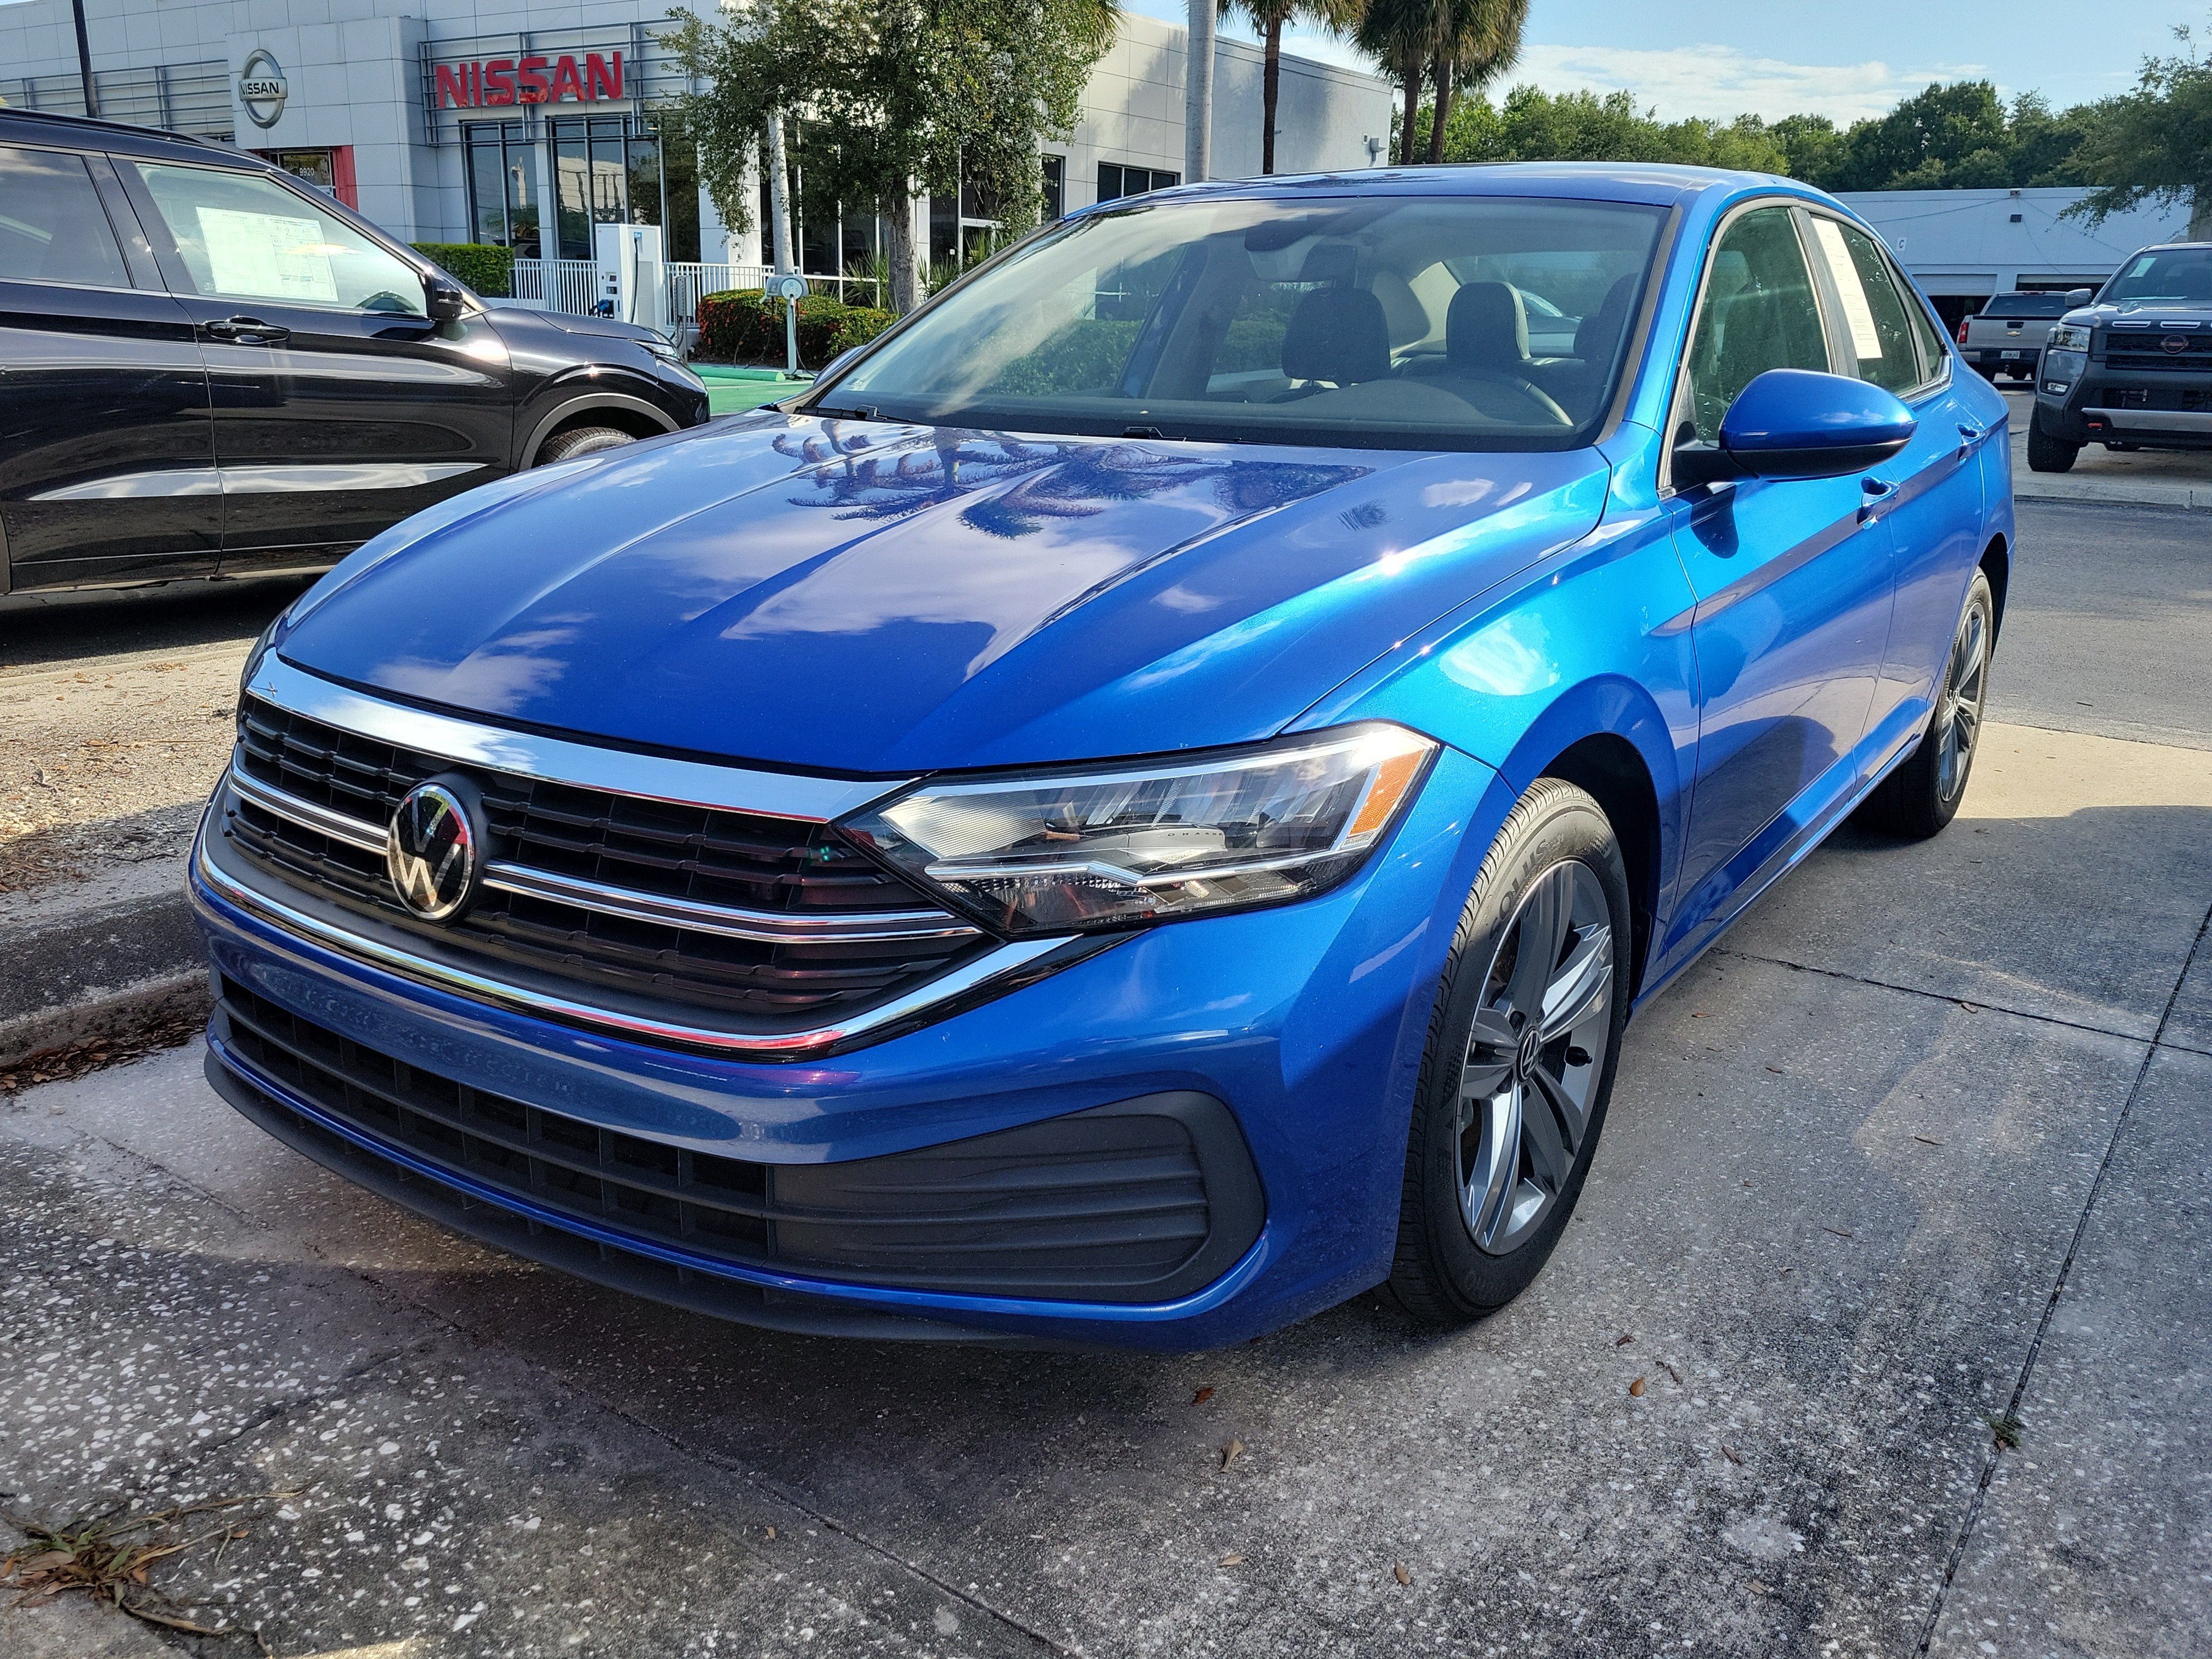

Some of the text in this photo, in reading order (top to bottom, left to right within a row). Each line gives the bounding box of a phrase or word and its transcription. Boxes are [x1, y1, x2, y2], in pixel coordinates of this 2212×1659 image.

[436, 51, 624, 109] NISSAN
[240, 82, 279, 95] NISSAN
[299, 167, 314, 176] 9920
[1899, 240, 1904, 249] C
[1489, 839, 1548, 940] SOLUS
